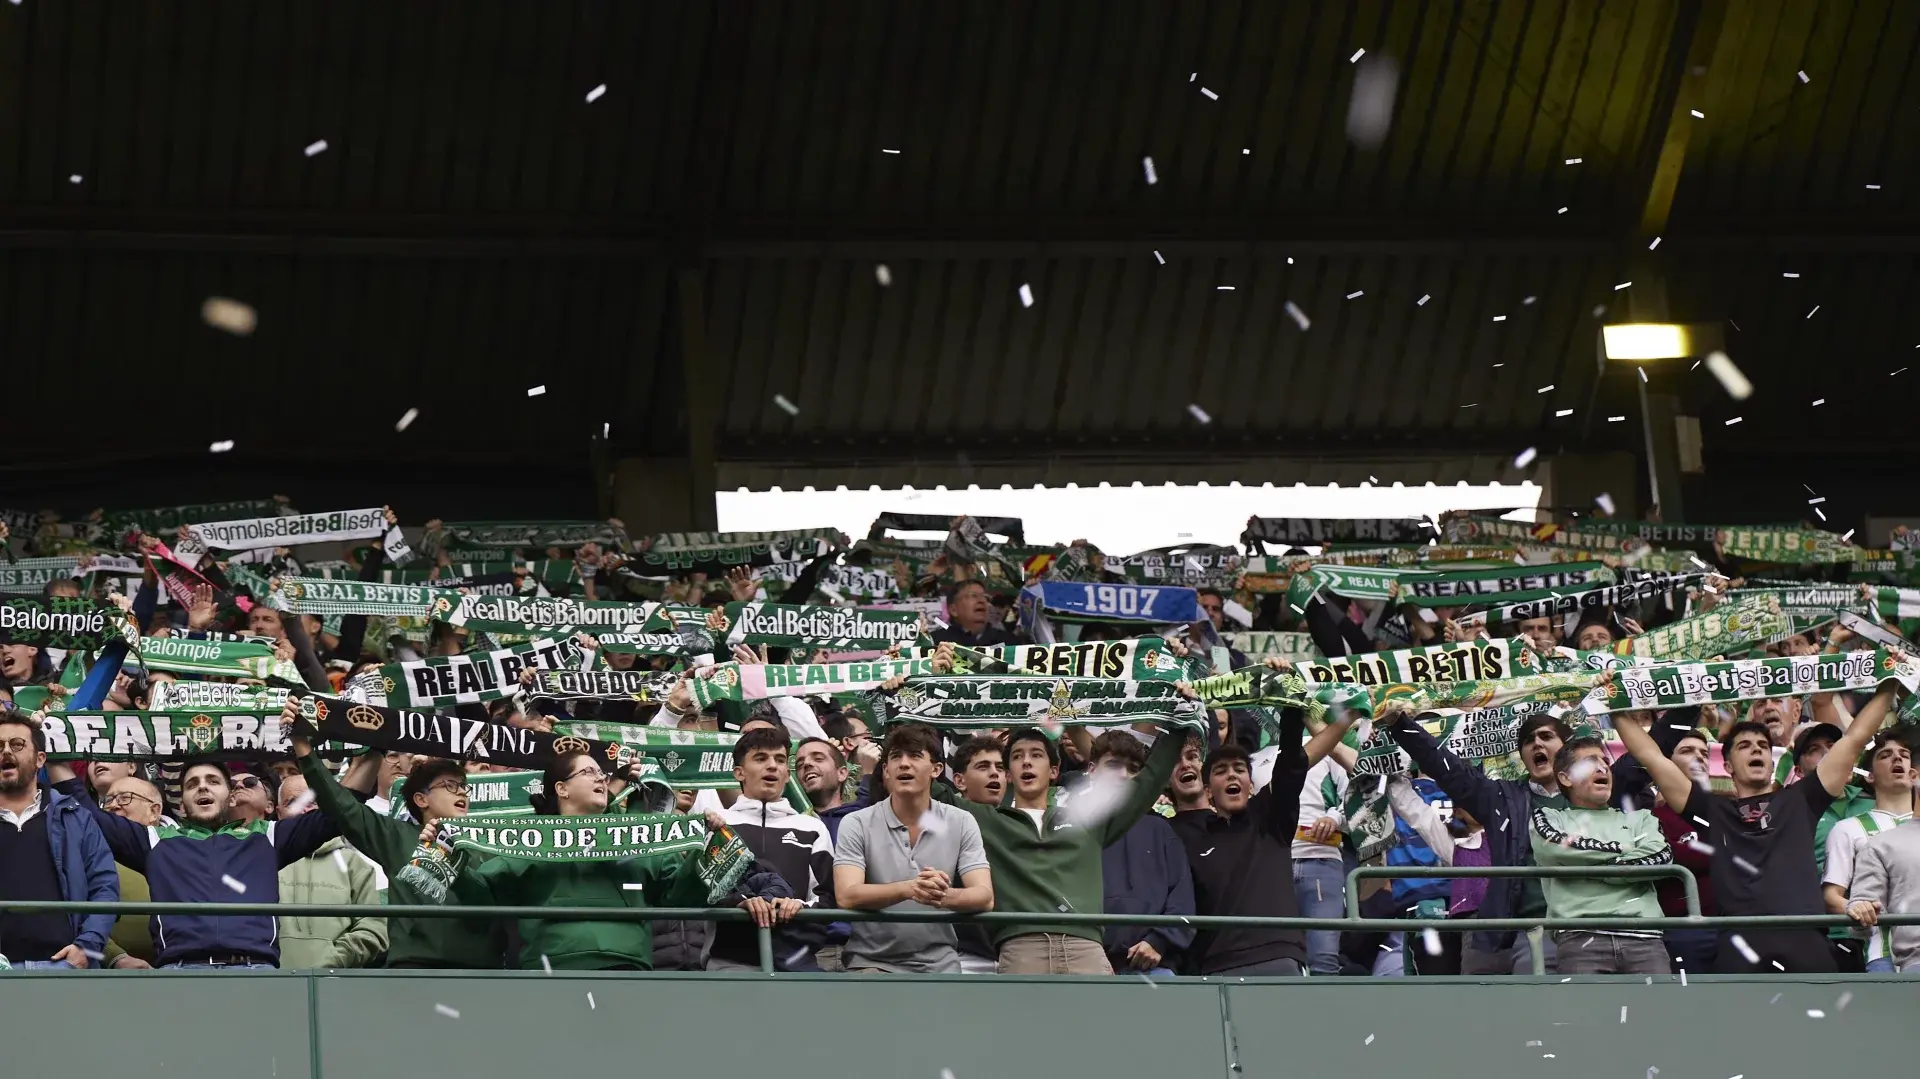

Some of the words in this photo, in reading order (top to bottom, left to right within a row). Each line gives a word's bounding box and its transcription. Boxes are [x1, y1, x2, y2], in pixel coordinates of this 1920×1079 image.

[304, 583, 359, 600] REAL
[364, 586, 421, 602] BETIS
[1348, 576, 1381, 589] REAL
[1413, 577, 1492, 598] REAL
[1500, 571, 1586, 592] BETIS
[1084, 585, 1160, 616] 1907
[0, 605, 104, 637] Balompié
[1634, 613, 1722, 658] BETIS
[1026, 642, 1128, 678] BETIS
[1408, 646, 1503, 683] BETIS
[413, 659, 498, 698] REAL
[559, 671, 642, 694] QUEDO
[764, 665, 845, 688] REAL
[200, 681, 241, 707] Betis
[990, 681, 1052, 700] BETIS
[1072, 681, 1126, 699] REAL
[941, 702, 1030, 716] BALOMPIE
[1465, 707, 1507, 723] FINAL
[42, 714, 188, 756] REAL
[1449, 732, 1497, 749] ESTADIO
[1463, 724, 1477, 736] de
[699, 751, 725, 773] REAL
[1456, 745, 1503, 758] MADRID
[1350, 751, 1404, 778] LOMPIE
[576, 816, 617, 824] LOCOS
[553, 827, 597, 849] DE
